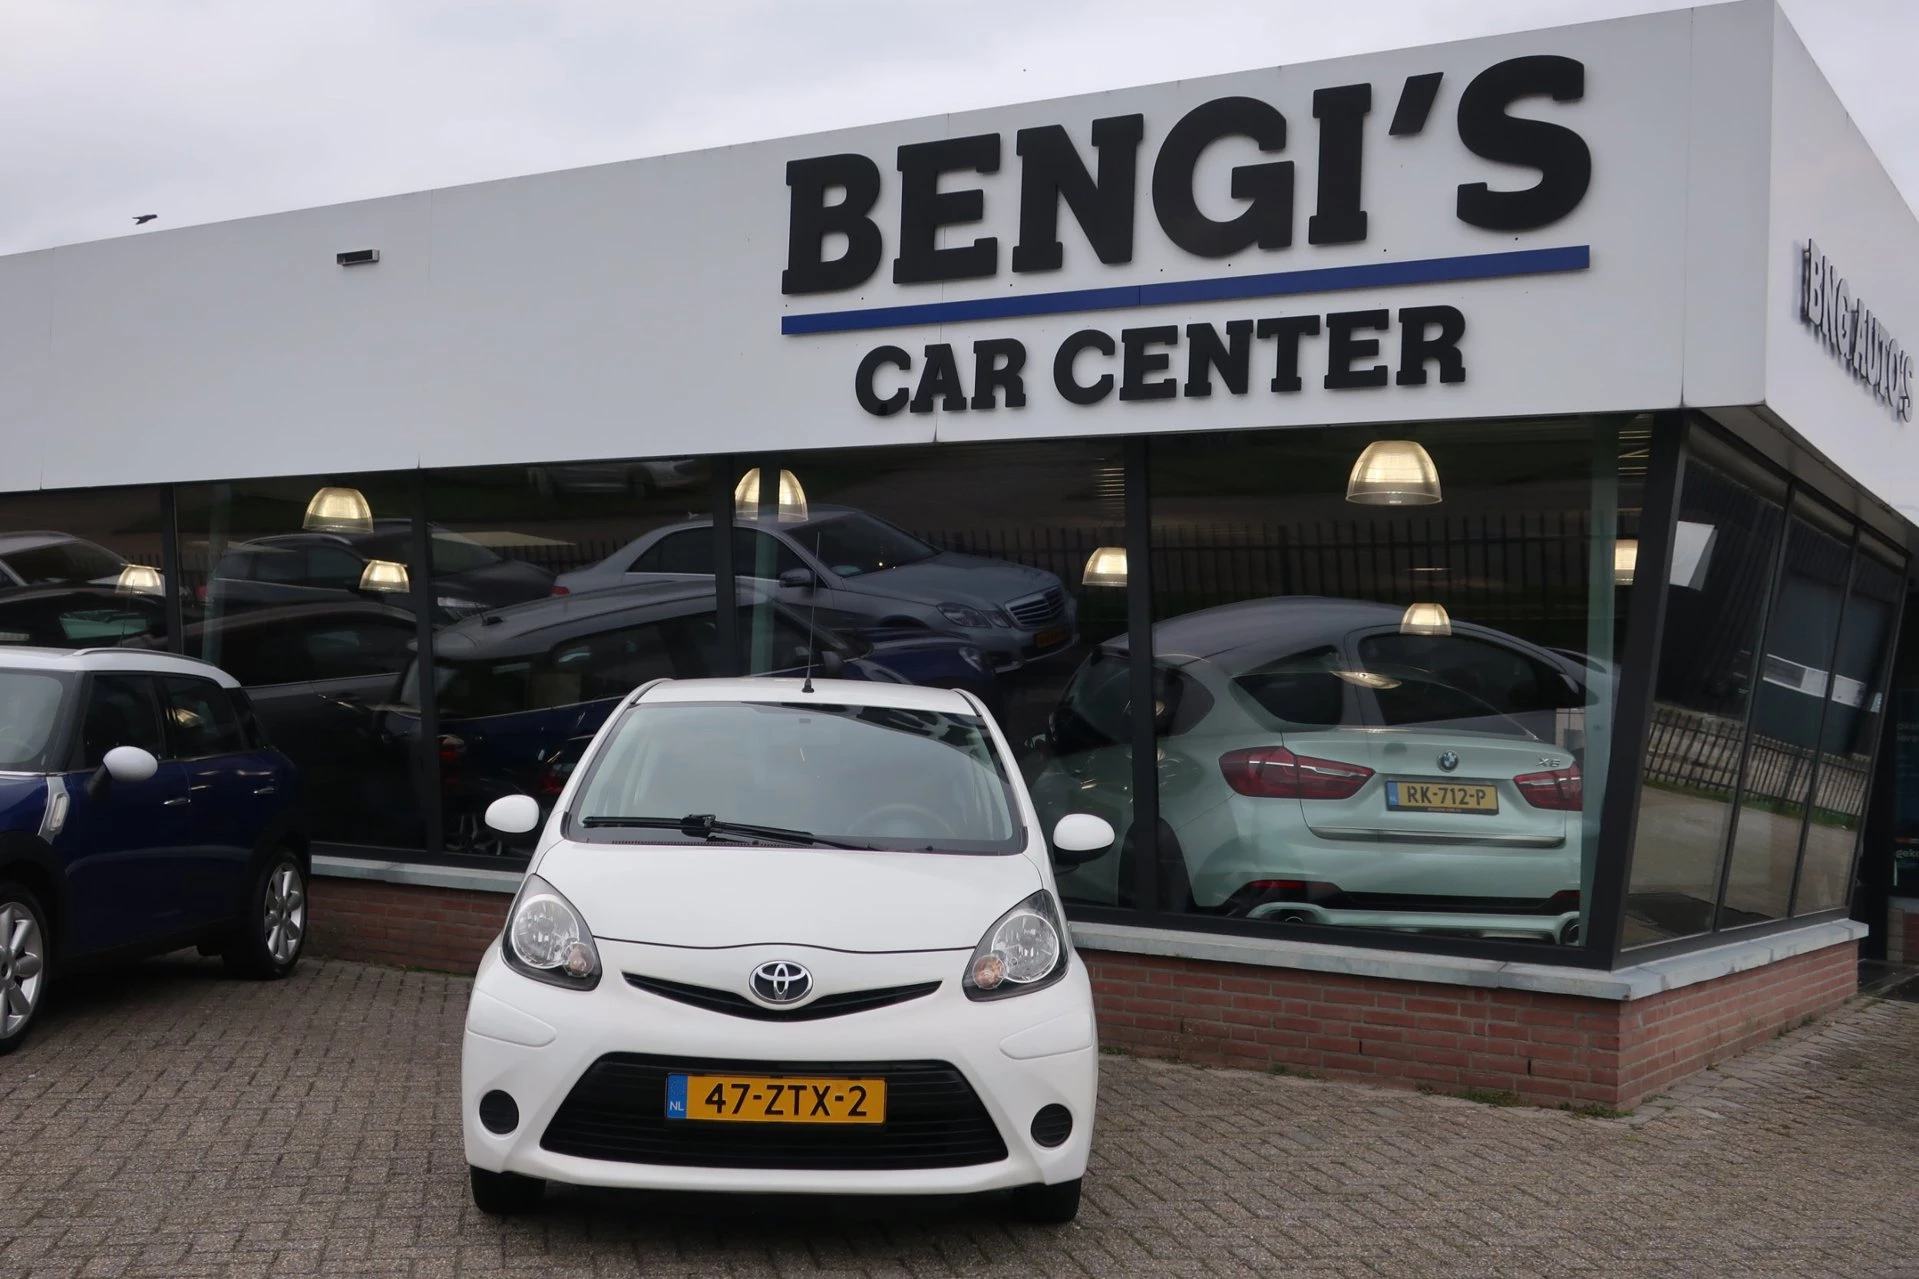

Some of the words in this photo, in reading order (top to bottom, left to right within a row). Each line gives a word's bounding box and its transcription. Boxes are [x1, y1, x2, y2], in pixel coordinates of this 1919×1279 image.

[782, 55, 1591, 295] BENGI'S
[856, 338, 1027, 416] CAR
[1053, 305, 1466, 405] CENTER
[1806, 238, 1853, 361] BNG
[1852, 298, 1913, 422] AUTO'S
[1407, 785, 1486, 806] RK-712-P
[669, 1101, 684, 1112] NL
[704, 1083, 867, 1117] 47-ZTX-2
